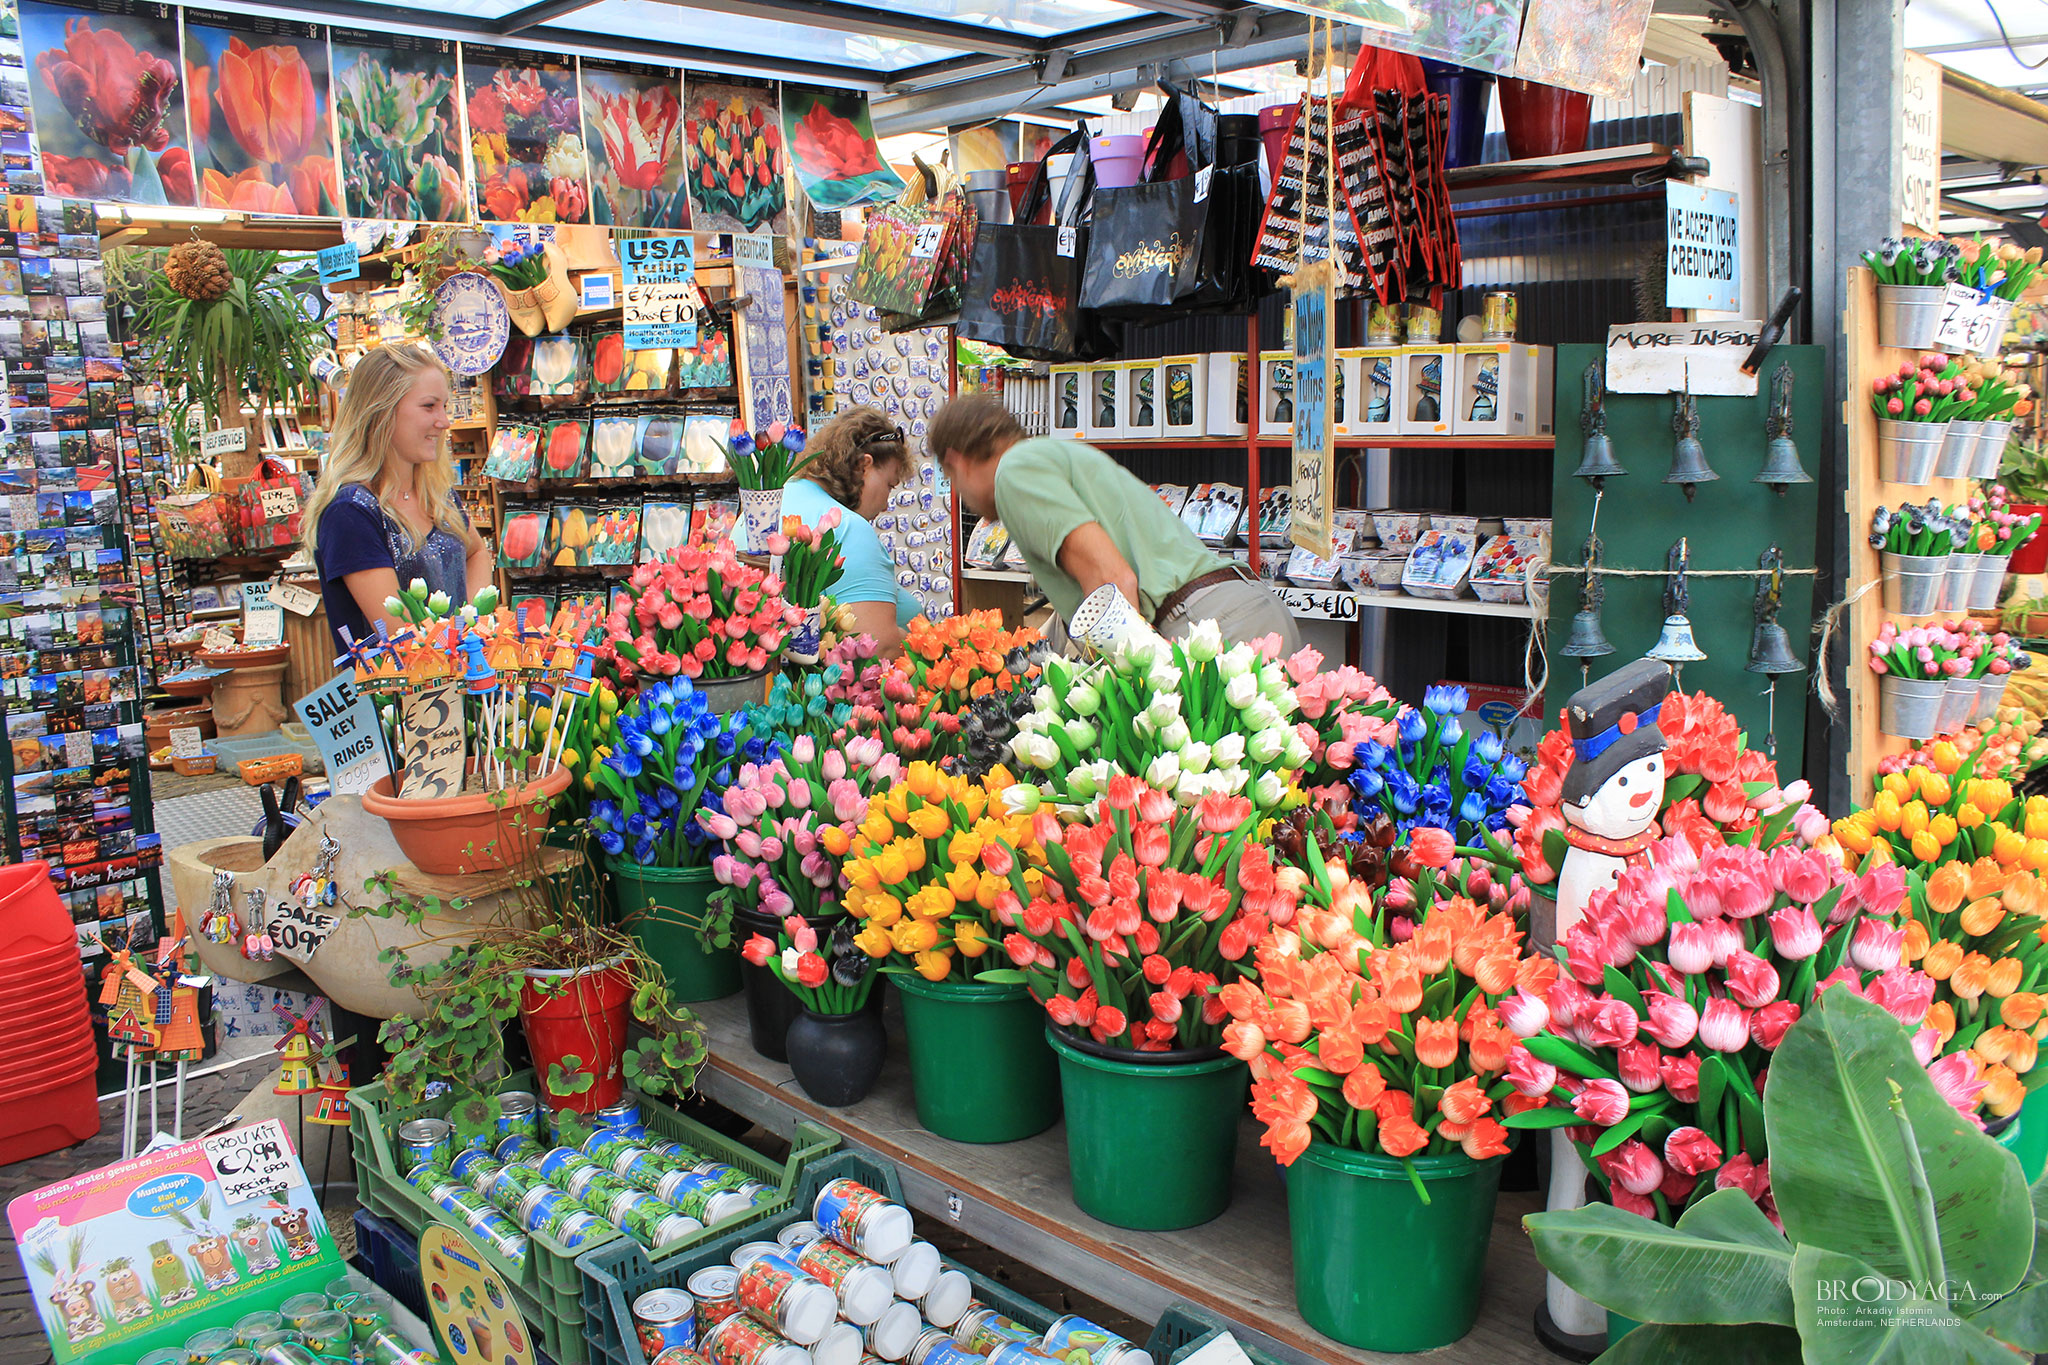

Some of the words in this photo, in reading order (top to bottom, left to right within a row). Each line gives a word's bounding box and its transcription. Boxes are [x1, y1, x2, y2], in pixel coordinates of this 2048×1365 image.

[335, 28, 351, 38] Green
[352, 31, 368, 39] Wave
[1669, 208, 1682, 240] WE
[1685, 210, 1714, 244] ACCEPT
[1716, 215, 1737, 247] YOUR
[628, 239, 691, 261] USA
[735, 237, 769, 262] CREDITCARD
[627, 260, 687, 275] Tulip
[1671, 244, 1733, 281] CREDITCARD
[637, 275, 680, 285] Bulbs
[660, 303, 694, 323] €10
[1938, 301, 1960, 337] 7
[1608, 330, 1684, 350] MORE
[1298, 370, 1323, 411] Tulips
[218, 432, 243, 447] SERVICE
[1301, 593, 1315, 612] 3
[1323, 594, 1358, 618] €10
[305, 682, 358, 727] SALE
[330, 715, 357, 740] KEY
[333, 735, 374, 767] RINGS
[429, 740, 463, 761] FOR
[277, 901, 335, 929] SALE
[33, 1182, 75, 1203] Zaaien,
[75, 1172, 105, 1187] water
[107, 1163, 138, 1180] geven
[140, 1158, 153, 1167] en
[165, 1149, 180, 1160] zie
[180, 1143, 199, 1155] het
[263, 1161, 290, 1174] EACH
[37, 1201, 52, 1212] Nu
[52, 1197, 71, 1207] met
[149, 1166, 164, 1176] EN
[158, 1191, 177, 1203] Hair
[151, 1201, 175, 1214] Grow
[176, 1195, 190, 1206] Kit
[70, 1342, 84, 1355] Er
[85, 1335, 106, 1350] zijn
[107, 1329, 122, 1340] nu
[123, 1314, 155, 1337] twaalf
[222, 1273, 268, 1298] Verzamel
[269, 1270, 281, 1280] ze
[282, 1258, 320, 1278] allemaal
